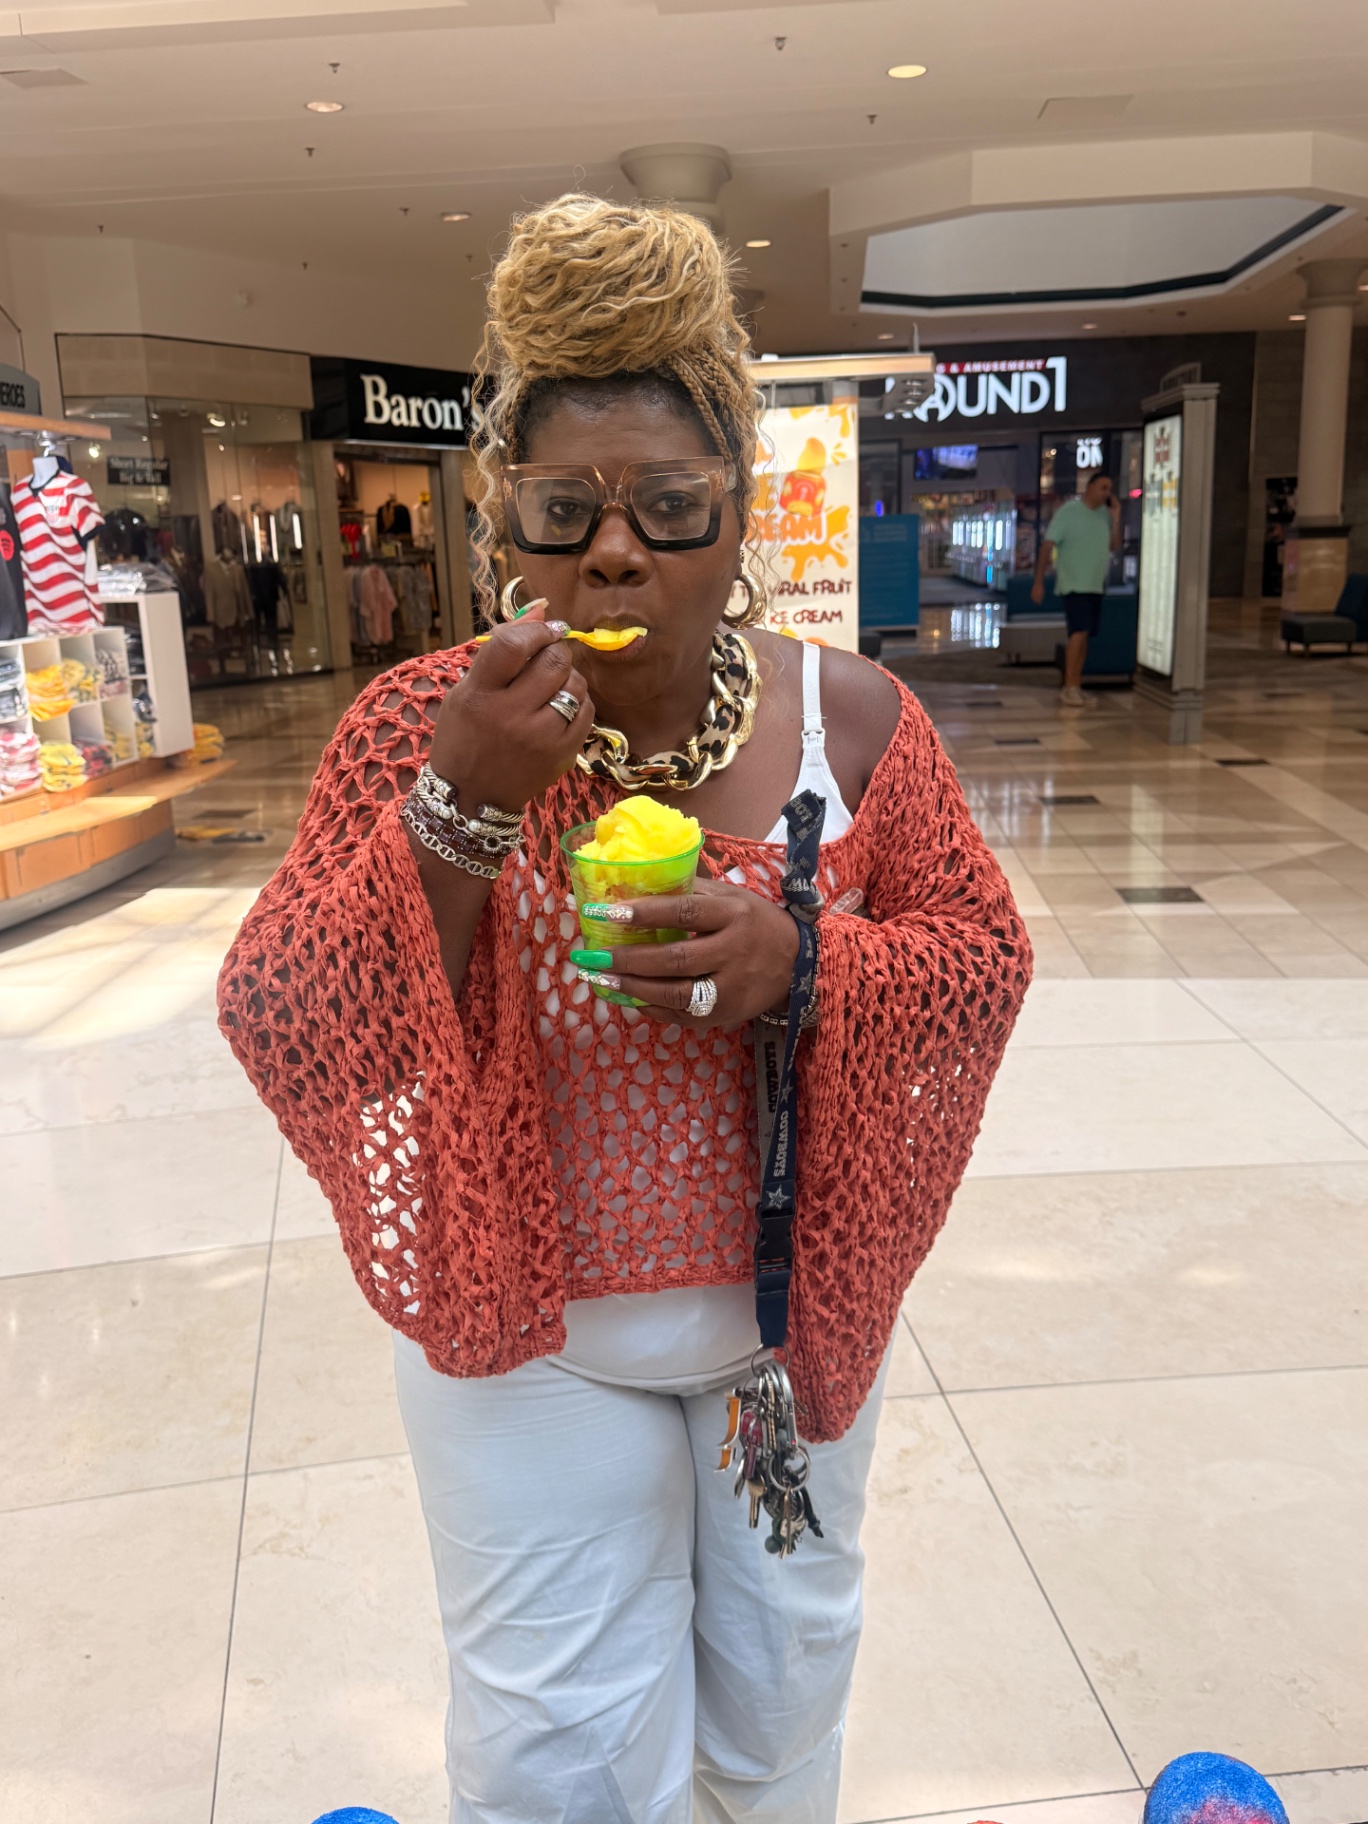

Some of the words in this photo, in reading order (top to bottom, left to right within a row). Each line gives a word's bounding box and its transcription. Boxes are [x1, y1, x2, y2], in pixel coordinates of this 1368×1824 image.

[950, 362, 960, 374] &
[963, 358, 1044, 373] AMUSEMENT
[793, 609, 843, 624] CREAM
[773, 1109, 789, 1177] COWBOYS
